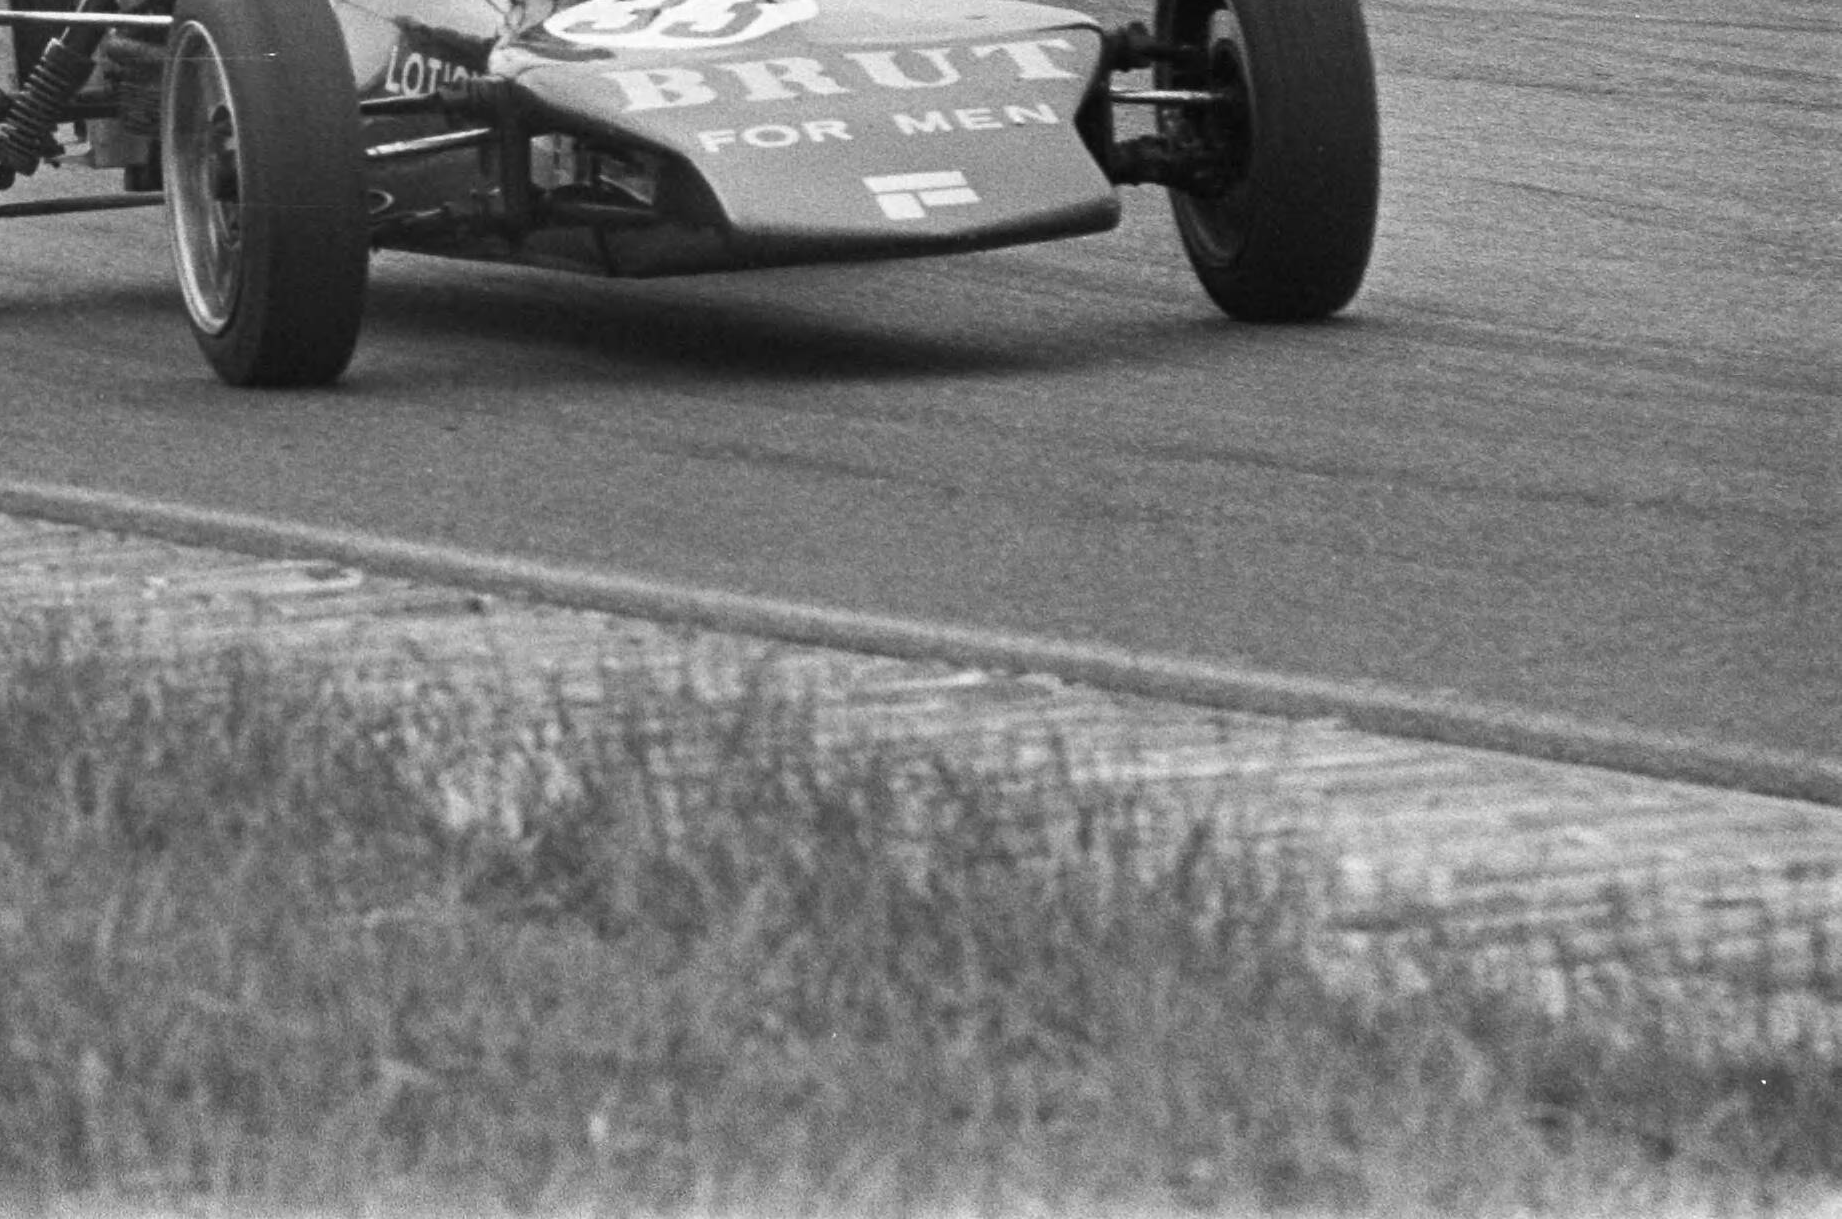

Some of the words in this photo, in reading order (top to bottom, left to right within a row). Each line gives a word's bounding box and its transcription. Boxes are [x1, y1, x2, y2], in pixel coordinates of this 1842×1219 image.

[599, 37, 1086, 113] BRUT
[696, 119, 854, 153] FOR
[891, 102, 1061, 136] MEN
